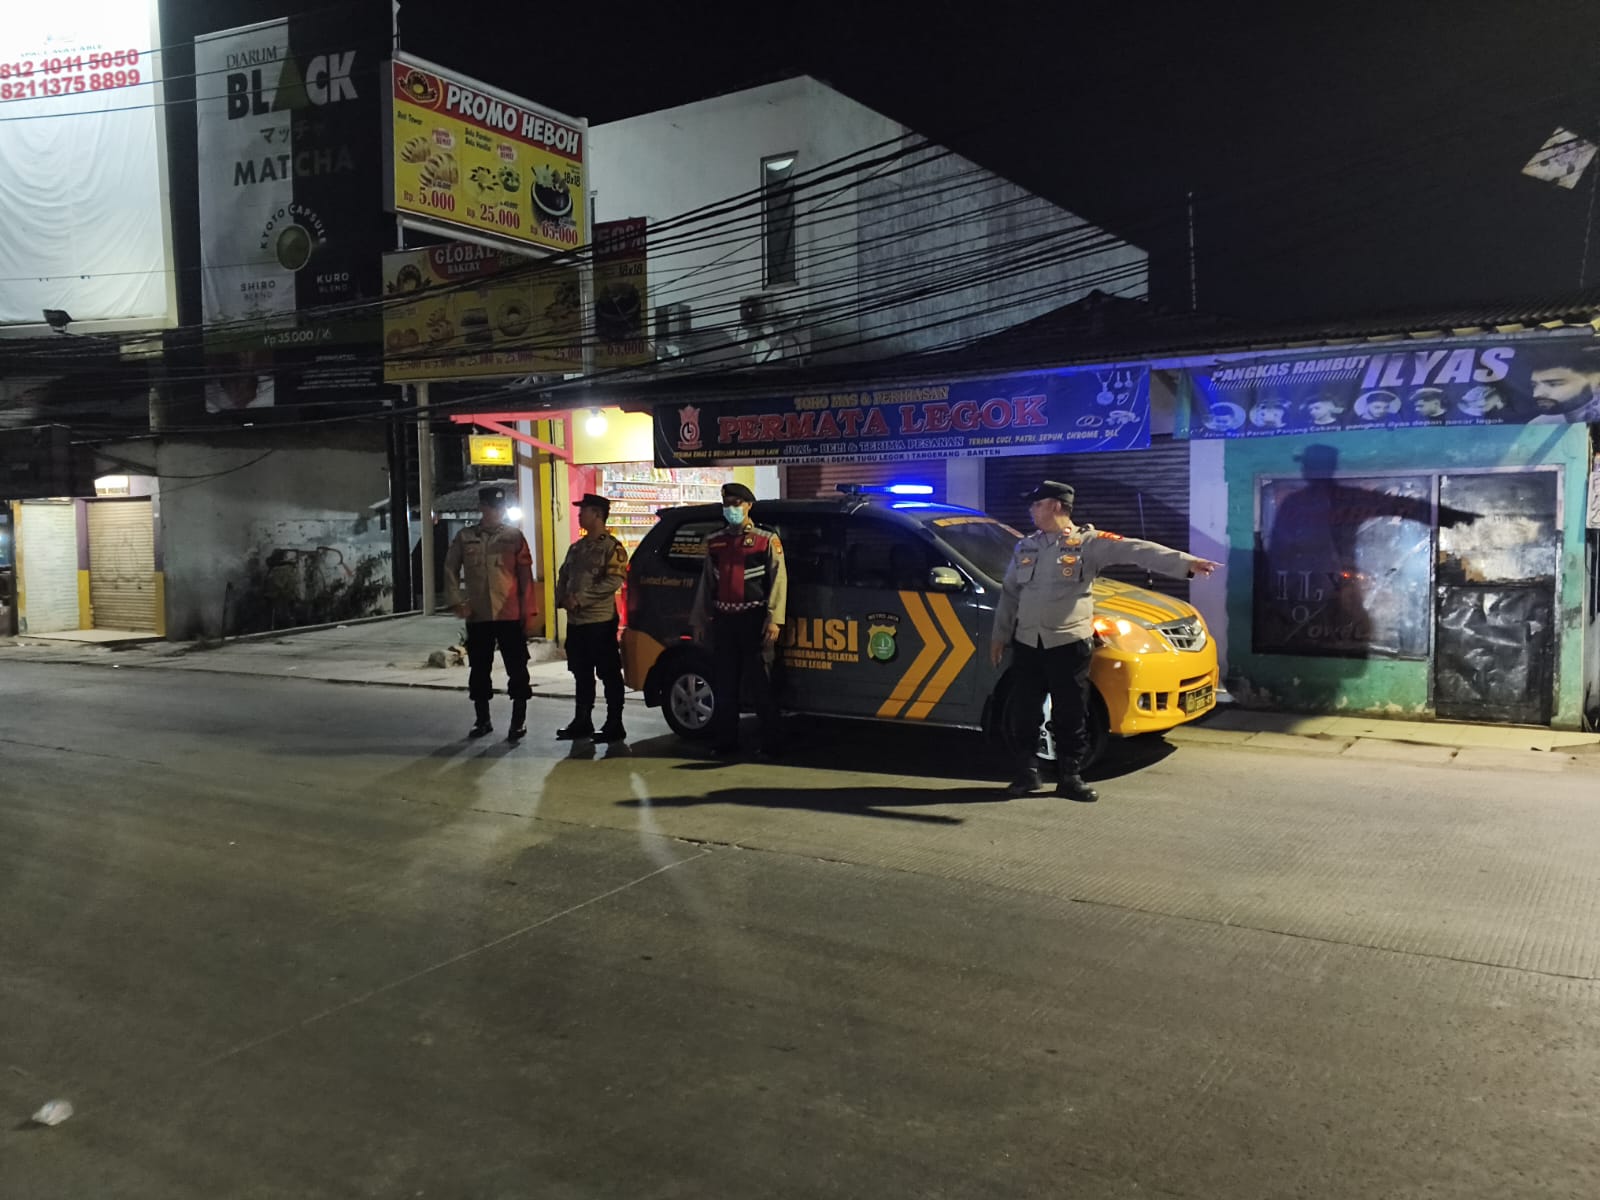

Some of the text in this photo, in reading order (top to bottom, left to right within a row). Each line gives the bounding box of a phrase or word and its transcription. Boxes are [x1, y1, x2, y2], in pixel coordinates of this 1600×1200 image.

[40, 55, 83, 75] 1011
[88, 48, 139, 71] 5050
[89, 69, 140, 91] 8899
[227, 50, 359, 121] BLACK
[446, 83, 518, 132] PROMO
[521, 112, 580, 155] HEBOH
[234, 144, 355, 186] MATCHA
[419, 186, 455, 212] 5.000
[260, 204, 328, 250] KYOTO CAPSULE
[480, 203, 520, 229] 25.000
[542, 221, 578, 245] 65.000
[435, 244, 496, 265] GLOBAL
[317, 273, 350, 285] KURO
[448, 261, 481, 274] BAKERY
[240, 280, 276, 292] SHIRO
[278, 329, 314, 345] 35.000
[1211, 346, 1516, 389] PANGKAS RAMBUT ILYAS
[717, 395, 1049, 444] PERMATA LEGOK
[859, 440, 905, 452] TERIMA
[908, 436, 965, 449] PESANAN
[968, 438, 994, 446] TERIMA
[778, 457, 800, 465] PASAR
[879, 453, 905, 461] LEGOK
[911, 451, 960, 460] TANGERANG
[967, 449, 1001, 457] BANTEN
[782, 617, 858, 652] OLISI
[808, 661, 833, 670] LEGOK
[827, 653, 859, 662] SELATAN
